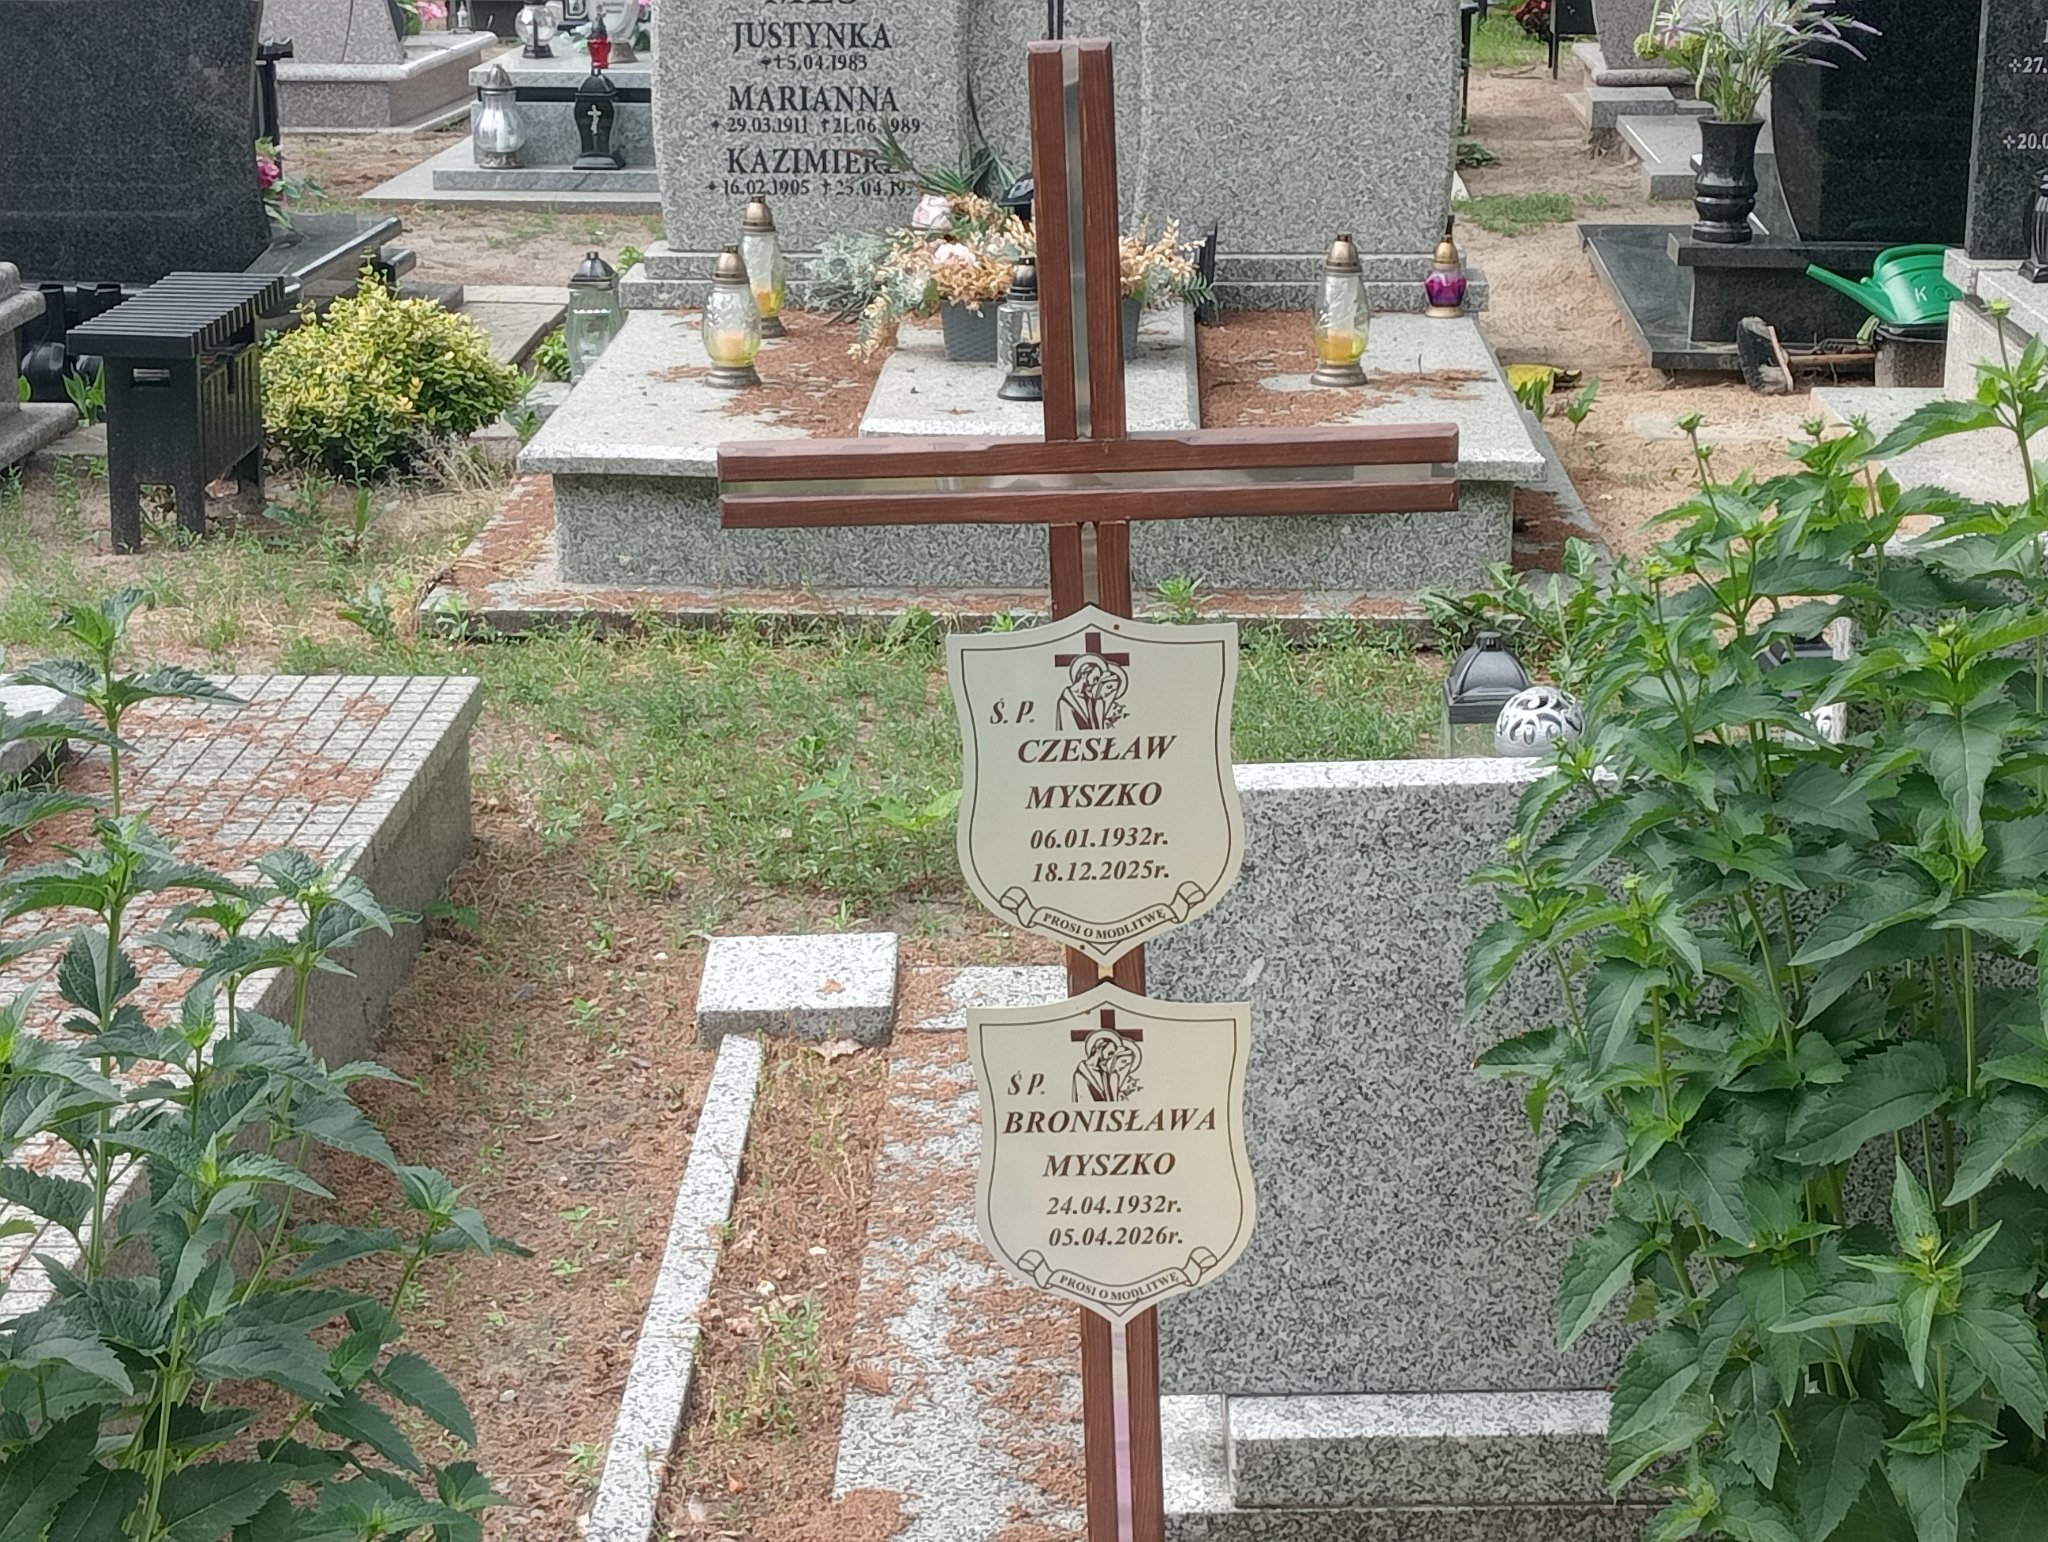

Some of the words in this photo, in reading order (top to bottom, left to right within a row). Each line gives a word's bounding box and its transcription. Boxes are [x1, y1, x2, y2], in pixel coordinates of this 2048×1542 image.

[732, 22, 893, 53] JUSTYNKA
[727, 86, 900, 112] MARIANNA
[1018, 735, 1178, 763] CZESŁAW
[1025, 782, 1162, 809] MYSZKO
[1030, 827, 1169, 850] 06.01.1932r.
[1031, 860, 1170, 882] 18.12.2025r.
[1043, 912, 1081, 935] PROSI
[1083, 927, 1094, 938] O
[1096, 908, 1167, 940] MODLITWĘ
[1003, 1107, 1216, 1134] BRONISŁAWA
[1042, 1152, 1176, 1177] MYSZKO
[1046, 1195, 1182, 1216] 24.04.1932r.
[1048, 1226, 1184, 1248] 05.04.2026r.
[1059, 1274, 1097, 1297] PROSI
[1098, 1289, 1109, 1300] O
[1110, 1271, 1180, 1302] MODLITWĘ
